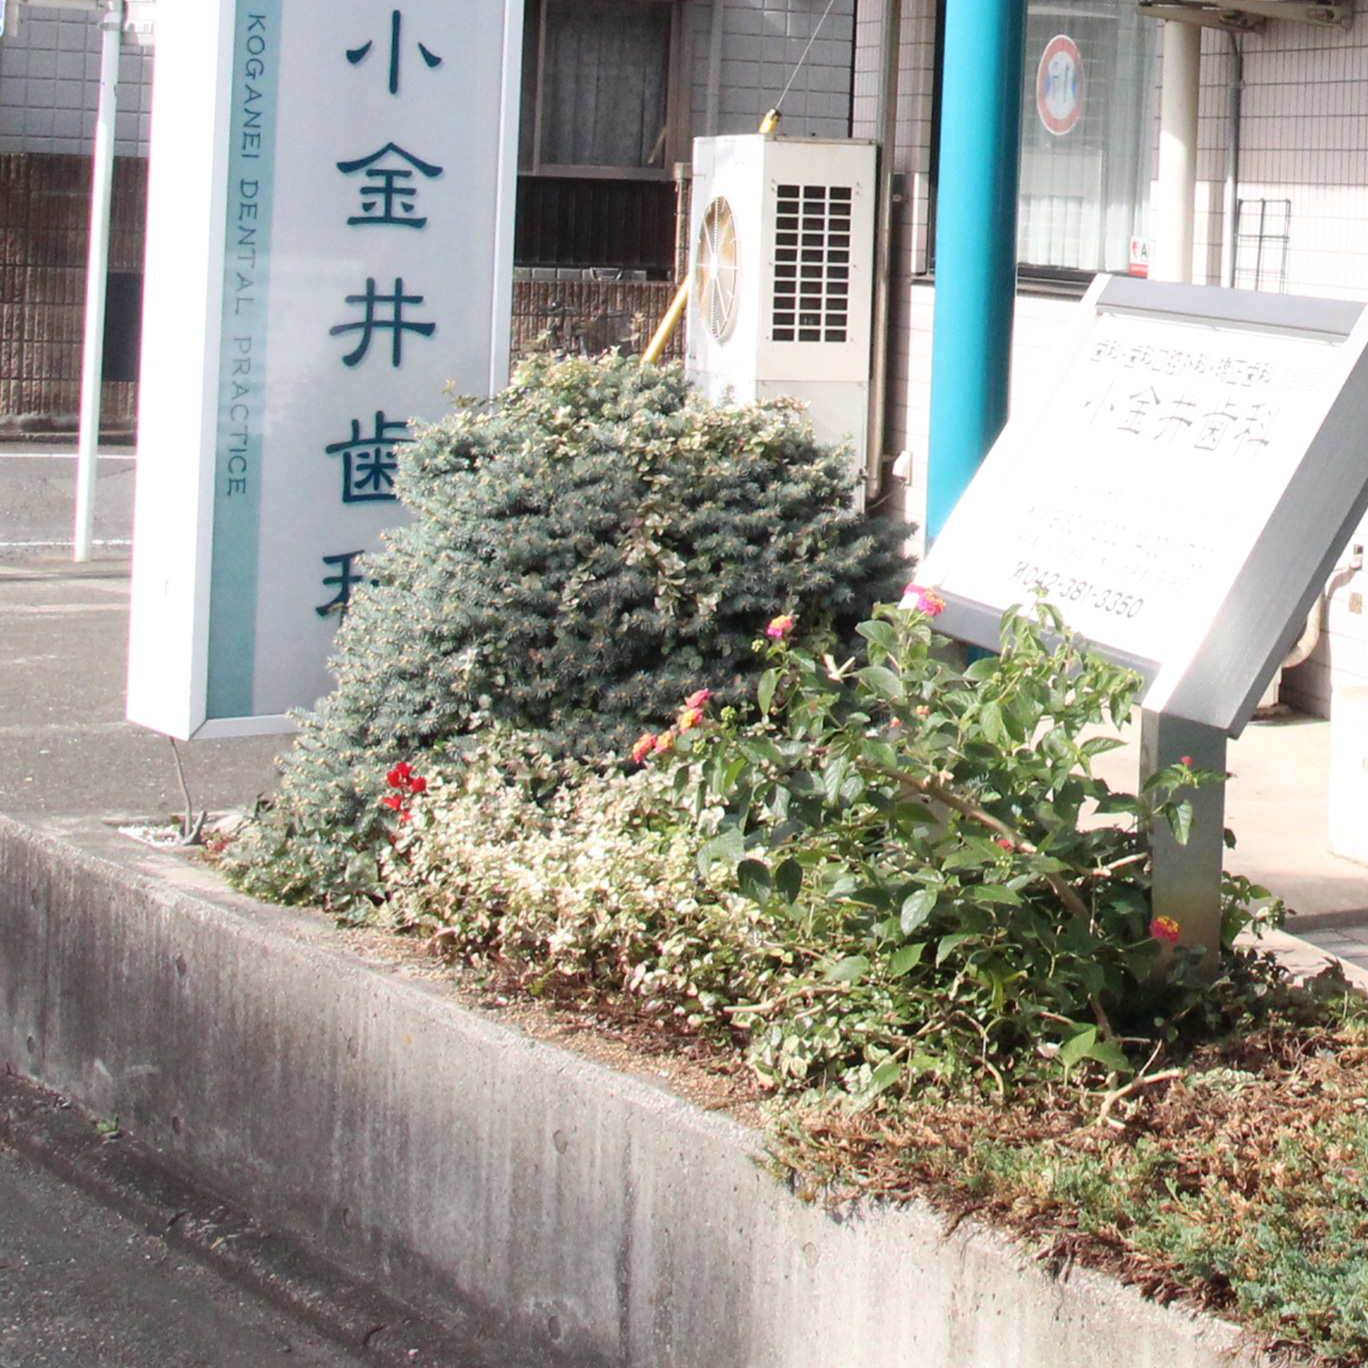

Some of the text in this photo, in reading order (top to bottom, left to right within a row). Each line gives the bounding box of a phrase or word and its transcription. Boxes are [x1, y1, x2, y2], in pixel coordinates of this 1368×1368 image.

[226, 14, 267, 497] KOGANEI DENTAL PRACTICE
[1083, 379, 1281, 459] 小金井歯科
